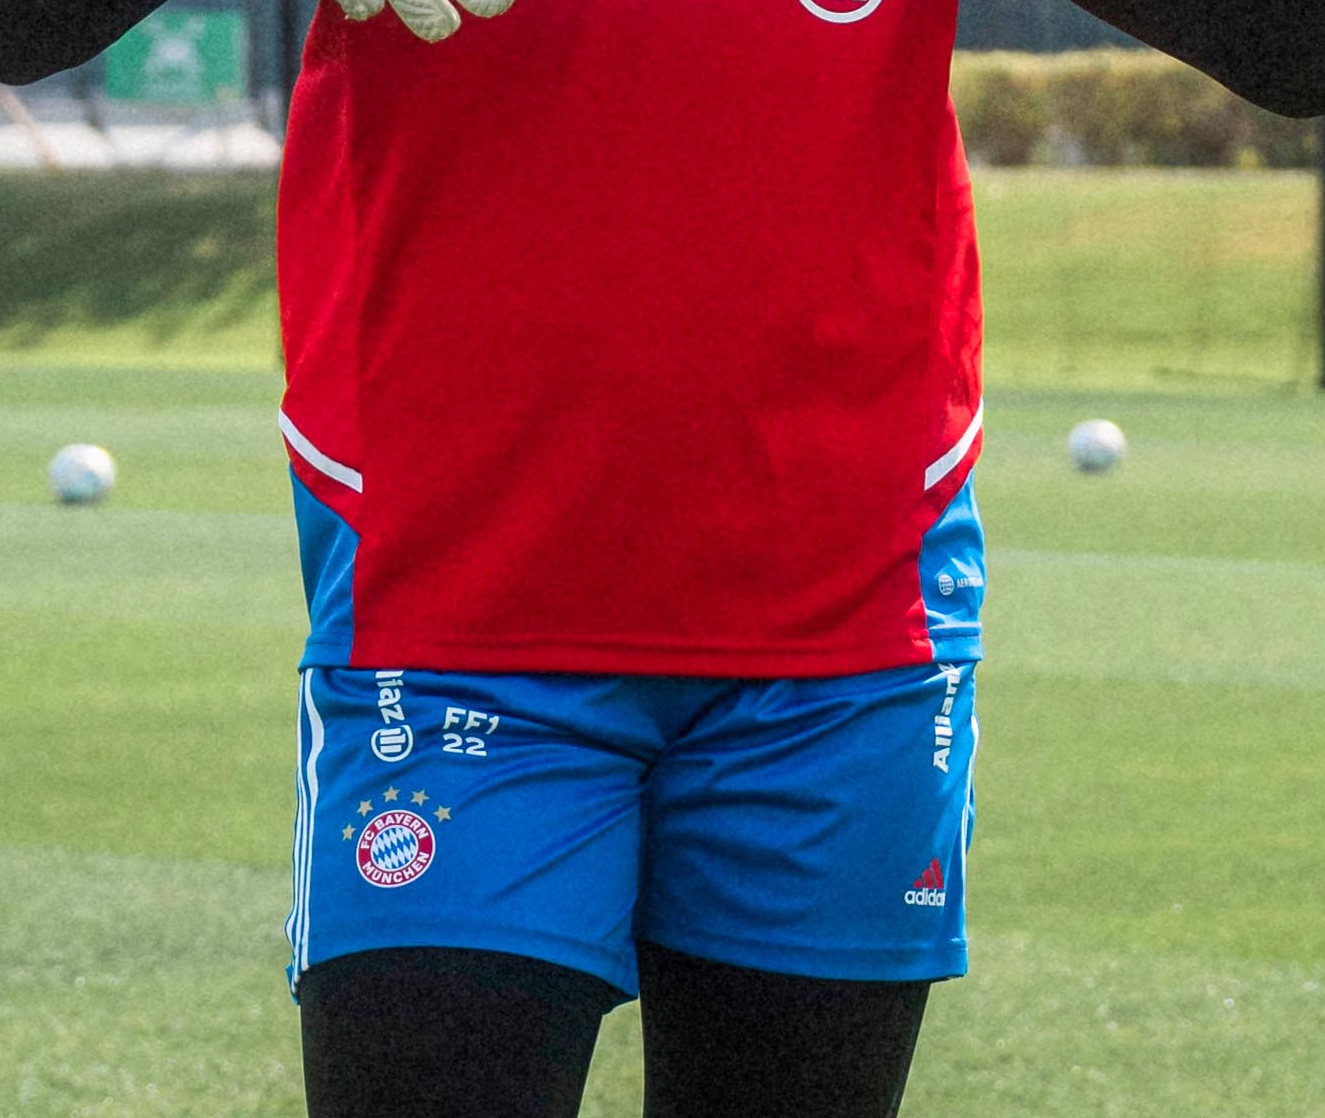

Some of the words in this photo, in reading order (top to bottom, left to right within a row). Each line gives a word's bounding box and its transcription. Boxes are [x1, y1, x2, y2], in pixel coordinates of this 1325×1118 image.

[442, 706, 500, 735] FF1
[442, 733, 487, 757] 22
[360, 830, 376, 849] FC
[374, 813, 429, 840] BAYERN
[904, 887, 946, 906] adida
